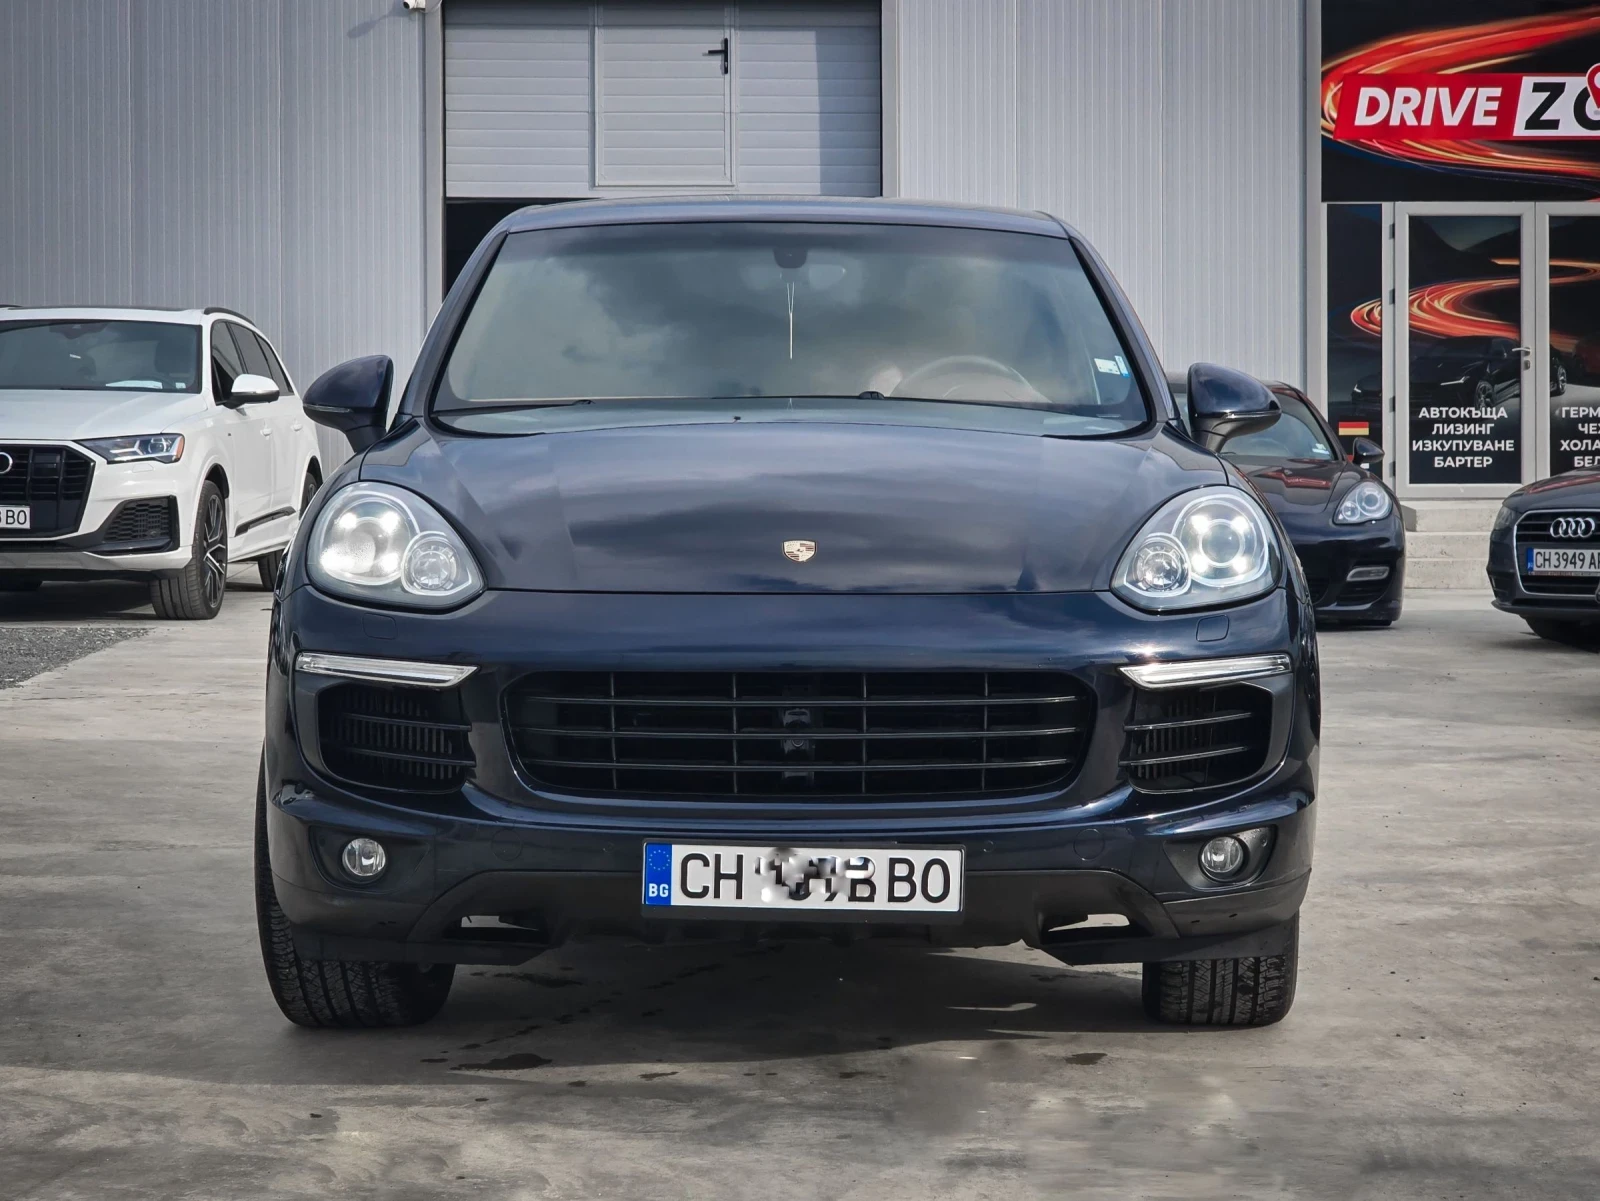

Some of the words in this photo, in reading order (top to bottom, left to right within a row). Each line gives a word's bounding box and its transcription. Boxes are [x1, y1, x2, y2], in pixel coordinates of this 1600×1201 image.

[1354, 87, 1502, 126] DRIVE
[1418, 407, 1508, 420] АВТОКЪЩА
[1432, 423, 1495, 435] ЛИЗИНГ
[1578, 423, 1600, 434] ЧЕ
[1412, 440, 1514, 451] ИЗКУПУВАНЕ
[1434, 456, 1493, 468] БАРТЕР
[1535, 551, 1551, 568] CH
[1553, 551, 1586, 569] 3949
[1588, 551, 1600, 569] A
[680, 853, 744, 900] CH
[887, 856, 951, 904] BO
[648, 883, 669, 898] BG
